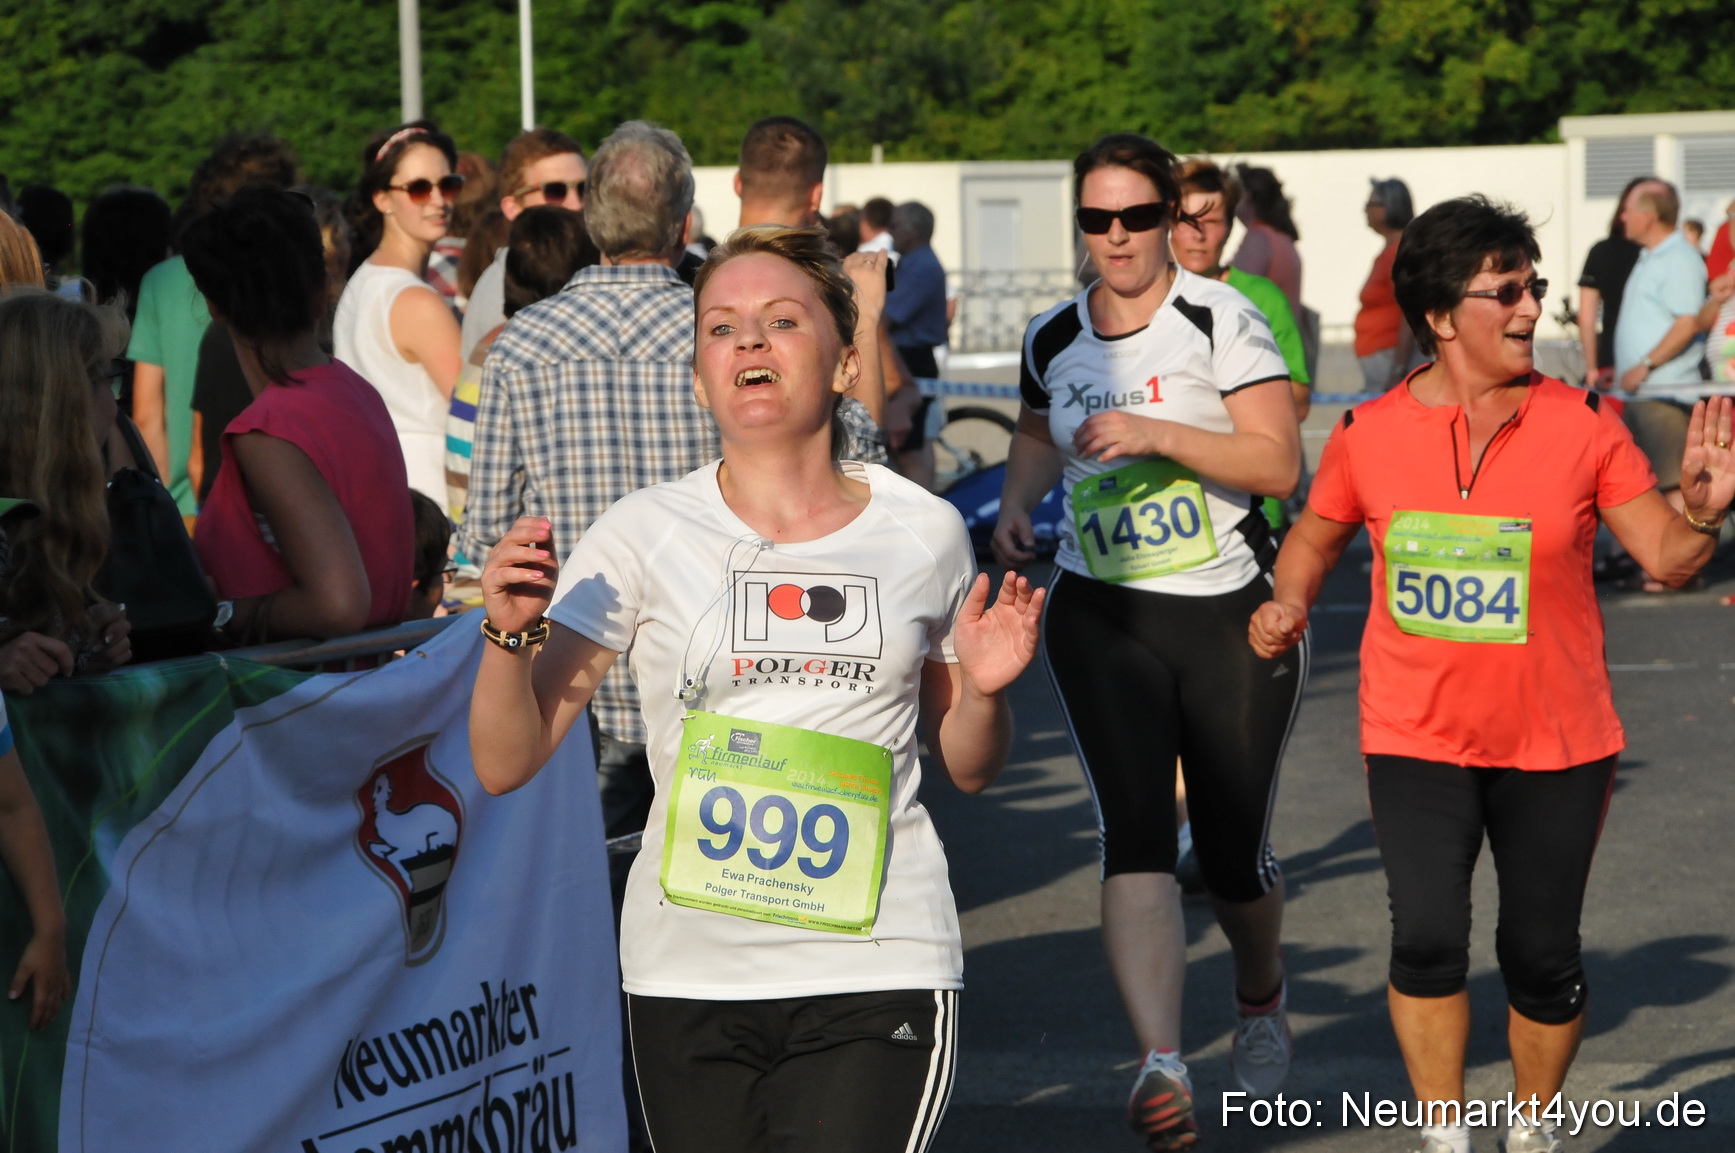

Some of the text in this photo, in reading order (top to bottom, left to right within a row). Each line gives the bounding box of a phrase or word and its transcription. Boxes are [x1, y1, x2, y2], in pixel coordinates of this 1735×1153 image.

[1082, 496, 1201, 556] 1430
[1396, 570, 1520, 623] 5084
[731, 658, 877, 682] POLGER
[732, 676, 874, 695] TRANSPORT
[711, 761, 743, 770] neumarkt
[712, 746, 788, 772] firmenlauf
[787, 769, 826, 785] 2014
[697, 785, 850, 880] 999
[721, 868, 815, 896] Ewa Prachensky
[705, 882, 825, 913] Polger Transport GmbH
[334, 979, 540, 1109] Neumarkter
[891, 1033, 918, 1041] adidas
